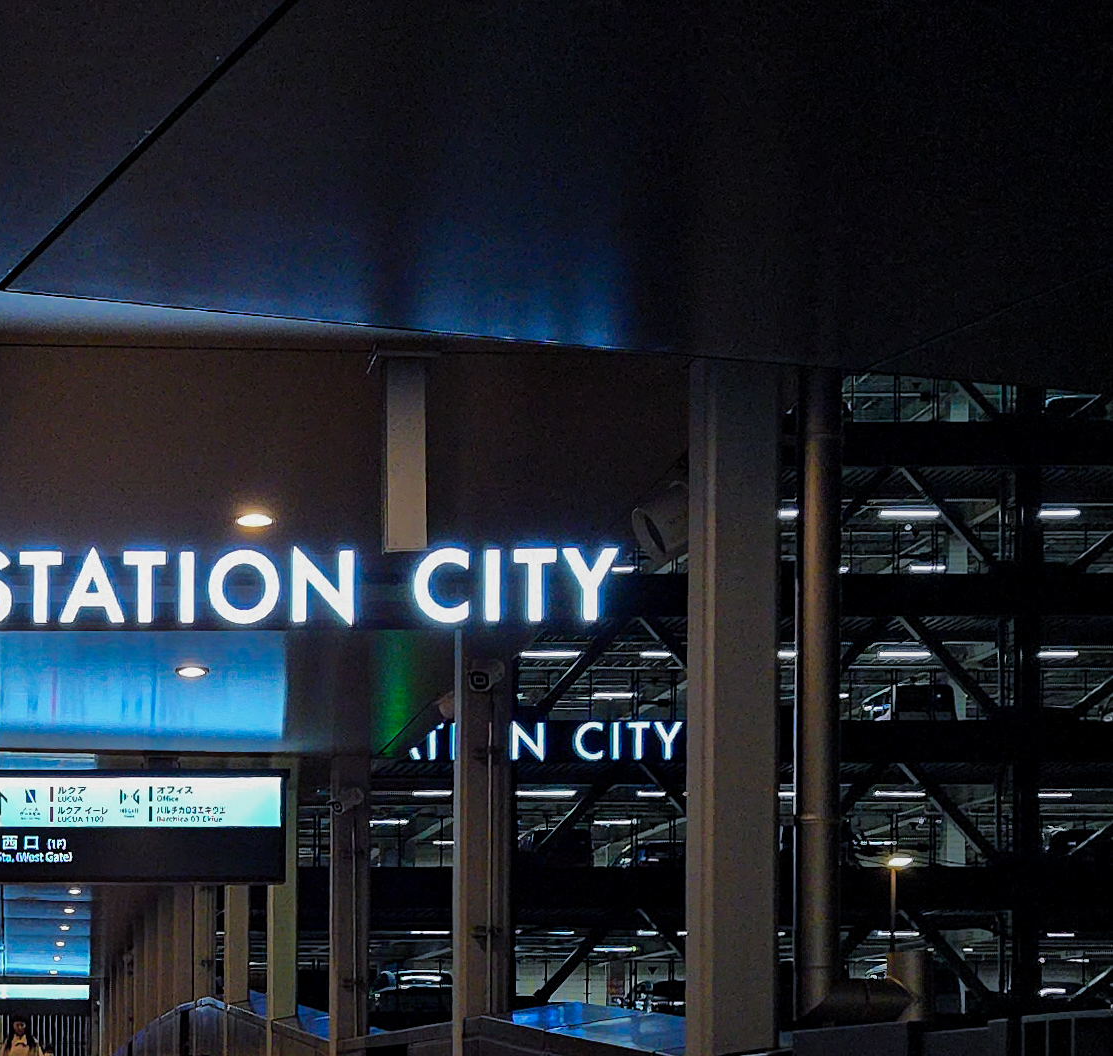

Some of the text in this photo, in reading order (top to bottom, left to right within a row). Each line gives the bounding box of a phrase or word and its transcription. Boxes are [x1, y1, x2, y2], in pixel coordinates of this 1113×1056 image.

[413, 546, 620, 624] CITY
[573, 721, 684, 762] CITY
[57, 786, 87, 795] ルクア
[156, 786, 193, 795] オフィス
[57, 795, 84, 803] LUCUA
[156, 795, 179, 803] Office
[57, 806, 82, 815] ルクア
[84, 806, 109, 815] イーレ
[57, 815, 84, 823] LUCUA
[16, 852, 45, 863] (West
[45, 852, 73, 863] Gate)
